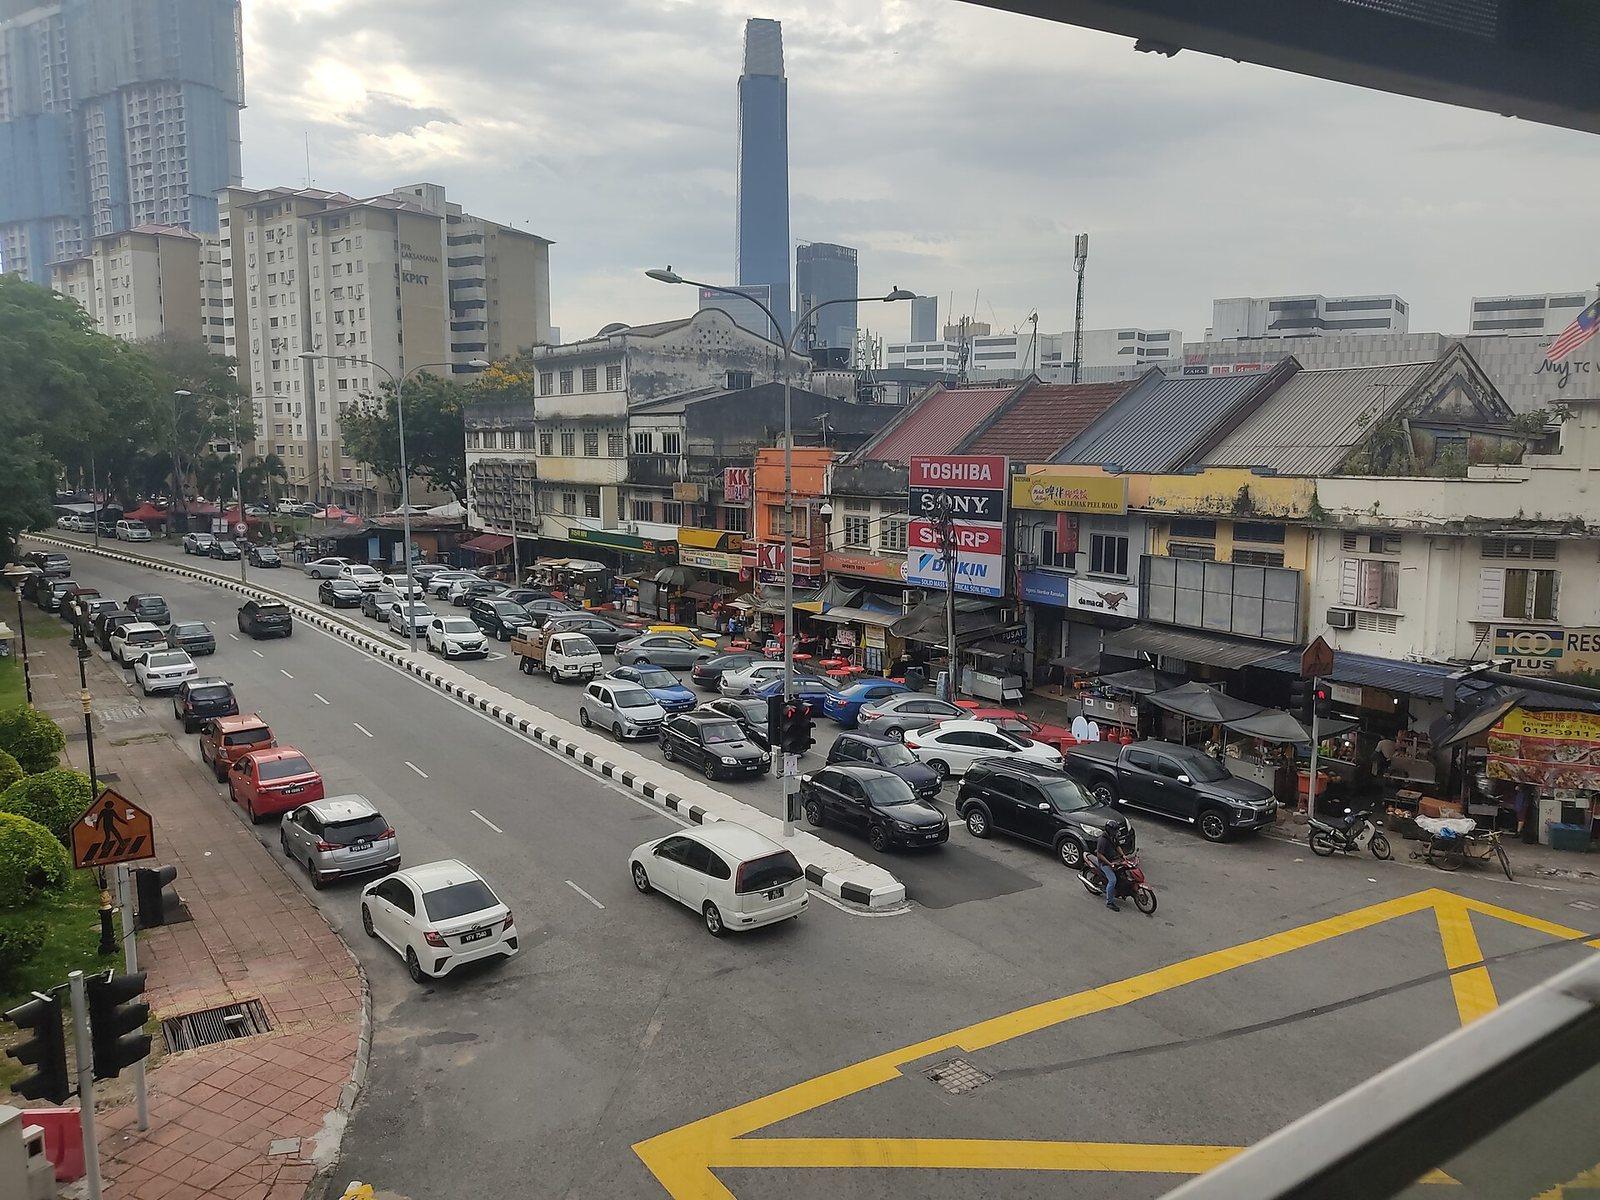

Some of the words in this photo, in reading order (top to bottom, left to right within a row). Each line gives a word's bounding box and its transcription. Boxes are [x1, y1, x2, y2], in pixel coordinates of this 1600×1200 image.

[401, 251, 439, 263] LAKSAMANA
[402, 272, 429, 285] KPKT
[729, 469, 748, 485] KK
[921, 463, 991, 480] TOSHIBA
[921, 493, 989, 514] SONY
[919, 527, 989, 547] SHARP
[659, 545, 676, 556] 99
[932, 558, 988, 578] DKIN
[934, 580, 946, 588] MASS
[1078, 596, 1087, 605] da
[1506, 632, 1552, 655] 100
